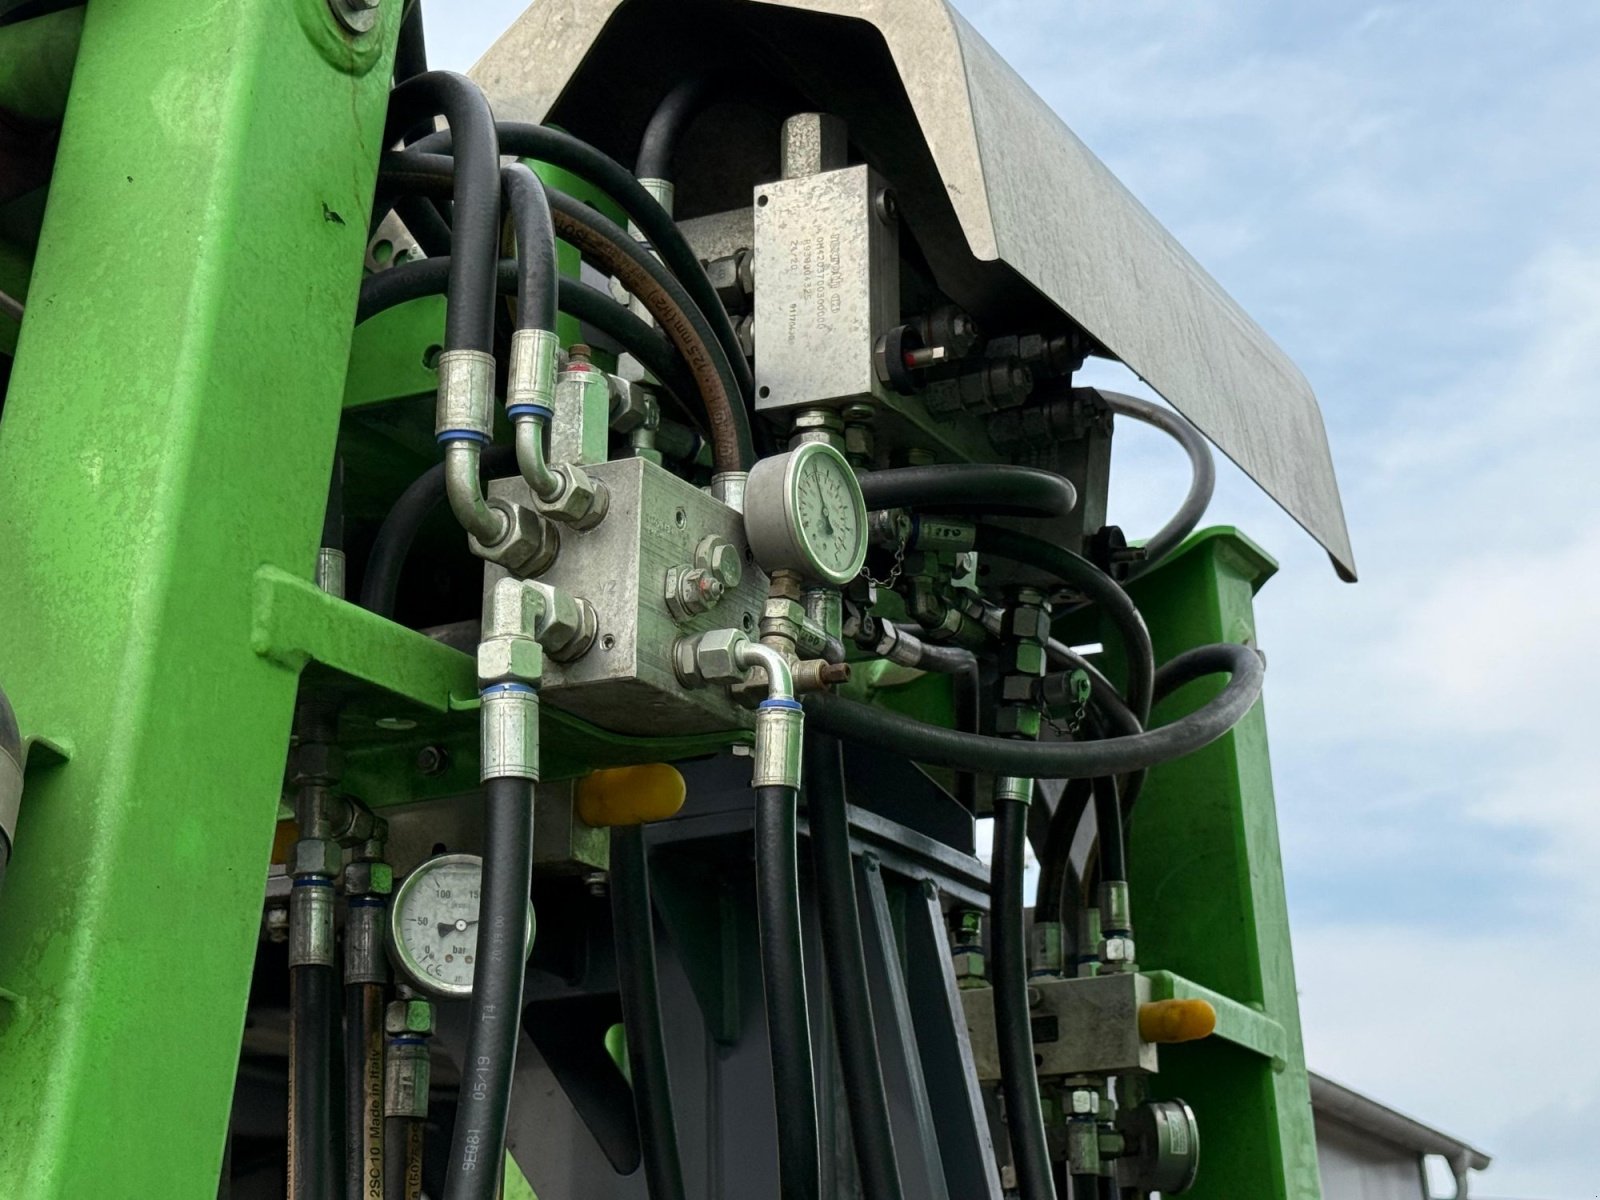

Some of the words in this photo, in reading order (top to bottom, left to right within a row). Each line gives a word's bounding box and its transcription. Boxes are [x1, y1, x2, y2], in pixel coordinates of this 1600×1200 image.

[673, 317, 694, 342] mm
[436, 889, 451, 899] 100
[469, 890, 479, 899] 15
[417, 917, 428, 926] 50
[424, 945, 431, 954] 0
[452, 945, 467, 954] bar
[472, 1056, 490, 1101] 05/19
[481, 1003, 497, 1022] T4
[369, 1048, 381, 1080] Italy
[369, 1083, 381, 1096] in
[369, 1100, 381, 1139] Made
[369, 1147, 381, 1164] 10
[369, 1168, 381, 1199] 2SC
